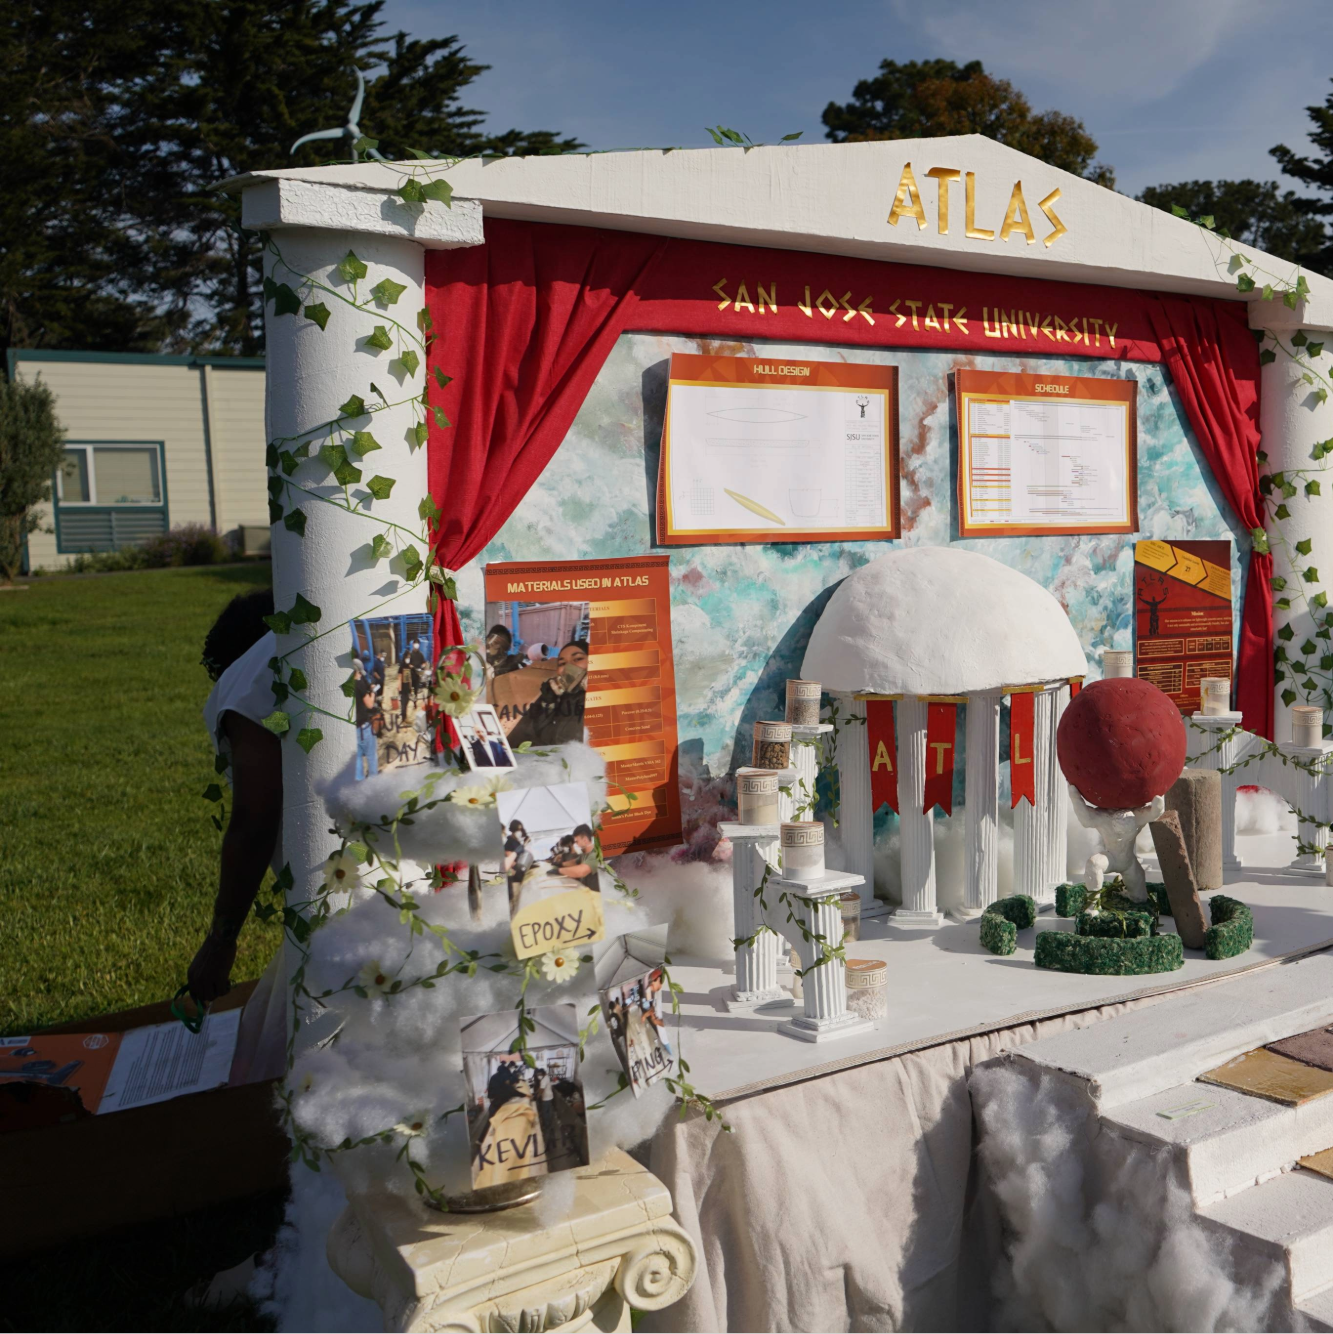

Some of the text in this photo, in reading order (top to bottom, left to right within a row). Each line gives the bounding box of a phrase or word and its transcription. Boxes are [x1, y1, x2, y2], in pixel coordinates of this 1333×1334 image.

[887, 161, 1068, 249] ATLAS
[712, 277, 1119, 349] SAN JOSE STATE UNIVERSITY
[753, 363, 810, 376] HULL DESIGN
[1034, 383, 1070, 394] SCHEDULE
[507, 575, 649, 593] MATERIALS USED IN ATLAS
[385, 734, 422, 764] DAY
[872, 733, 1032, 775] A T L
[518, 909, 584, 950] EPOXY
